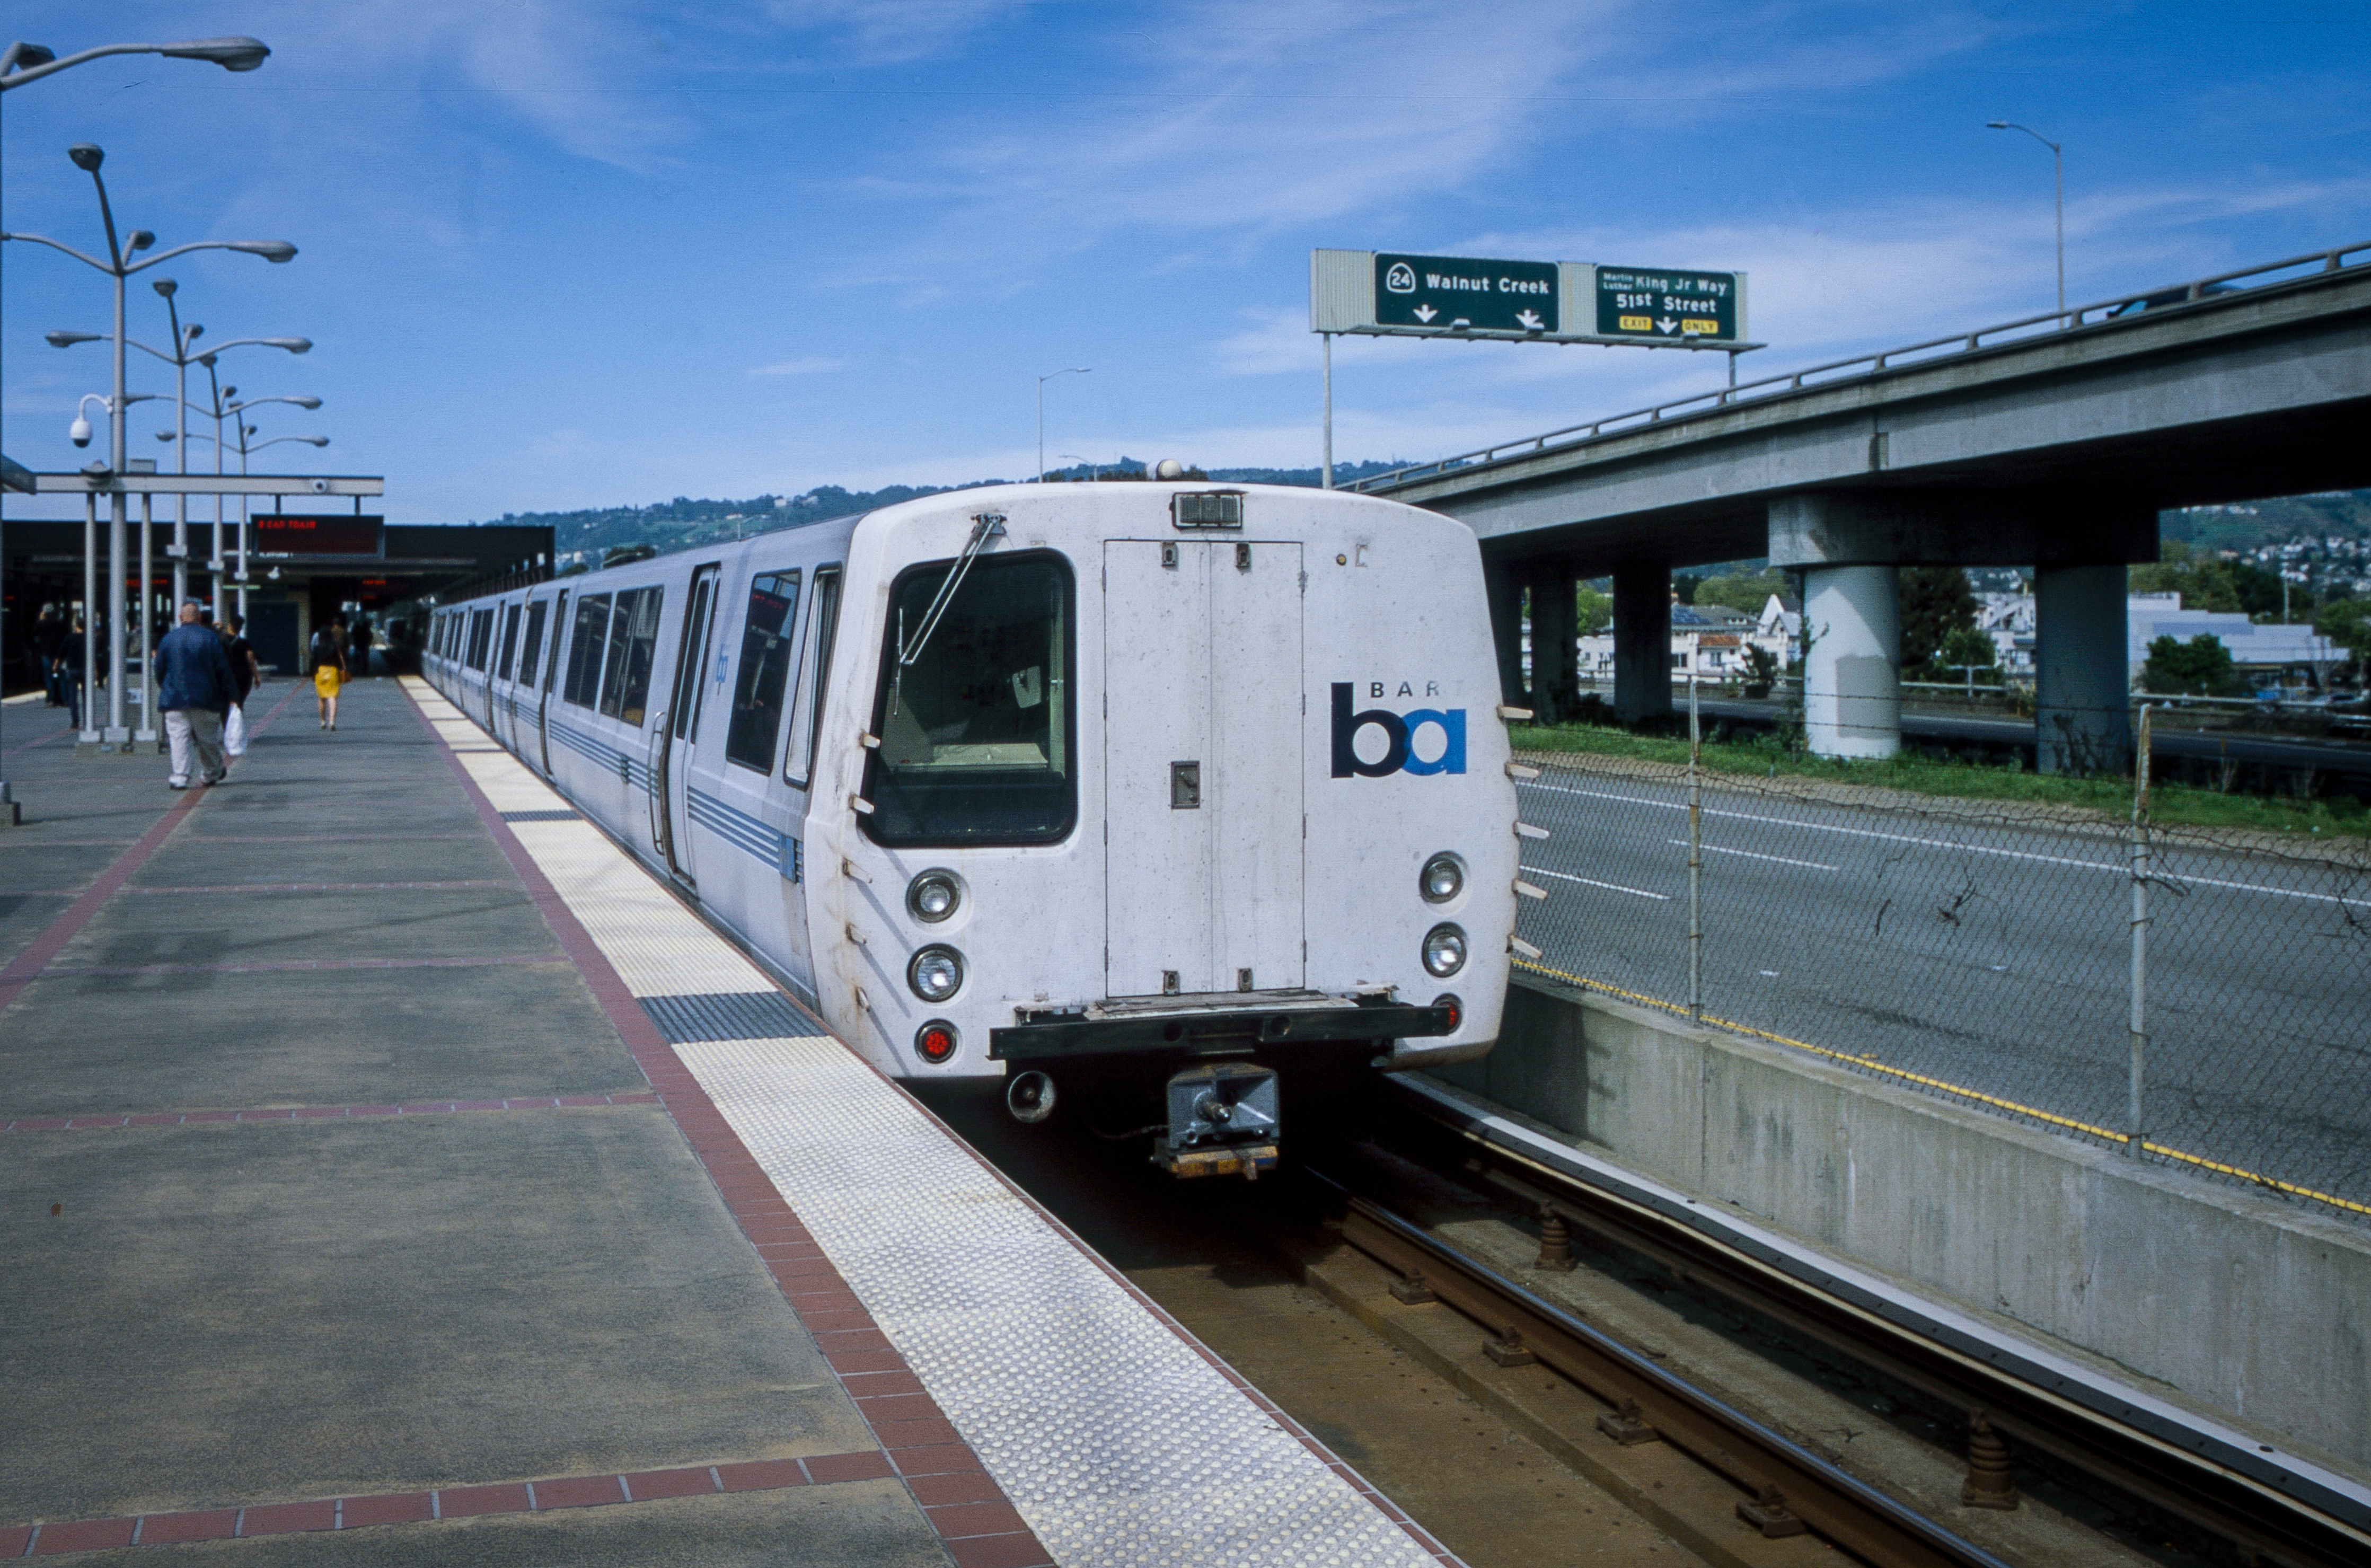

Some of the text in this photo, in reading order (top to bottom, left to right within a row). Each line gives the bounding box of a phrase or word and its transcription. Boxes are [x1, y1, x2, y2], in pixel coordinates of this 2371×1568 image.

[1391, 272, 1410, 287] 24
[1426, 273, 1549, 295] Walnut Creek
[1603, 272, 1634, 282] Martin
[1635, 275, 1727, 297] King Jr Way
[1617, 293, 1716, 313] 51st Street
[1623, 319, 1714, 332] EXIT ONLY
